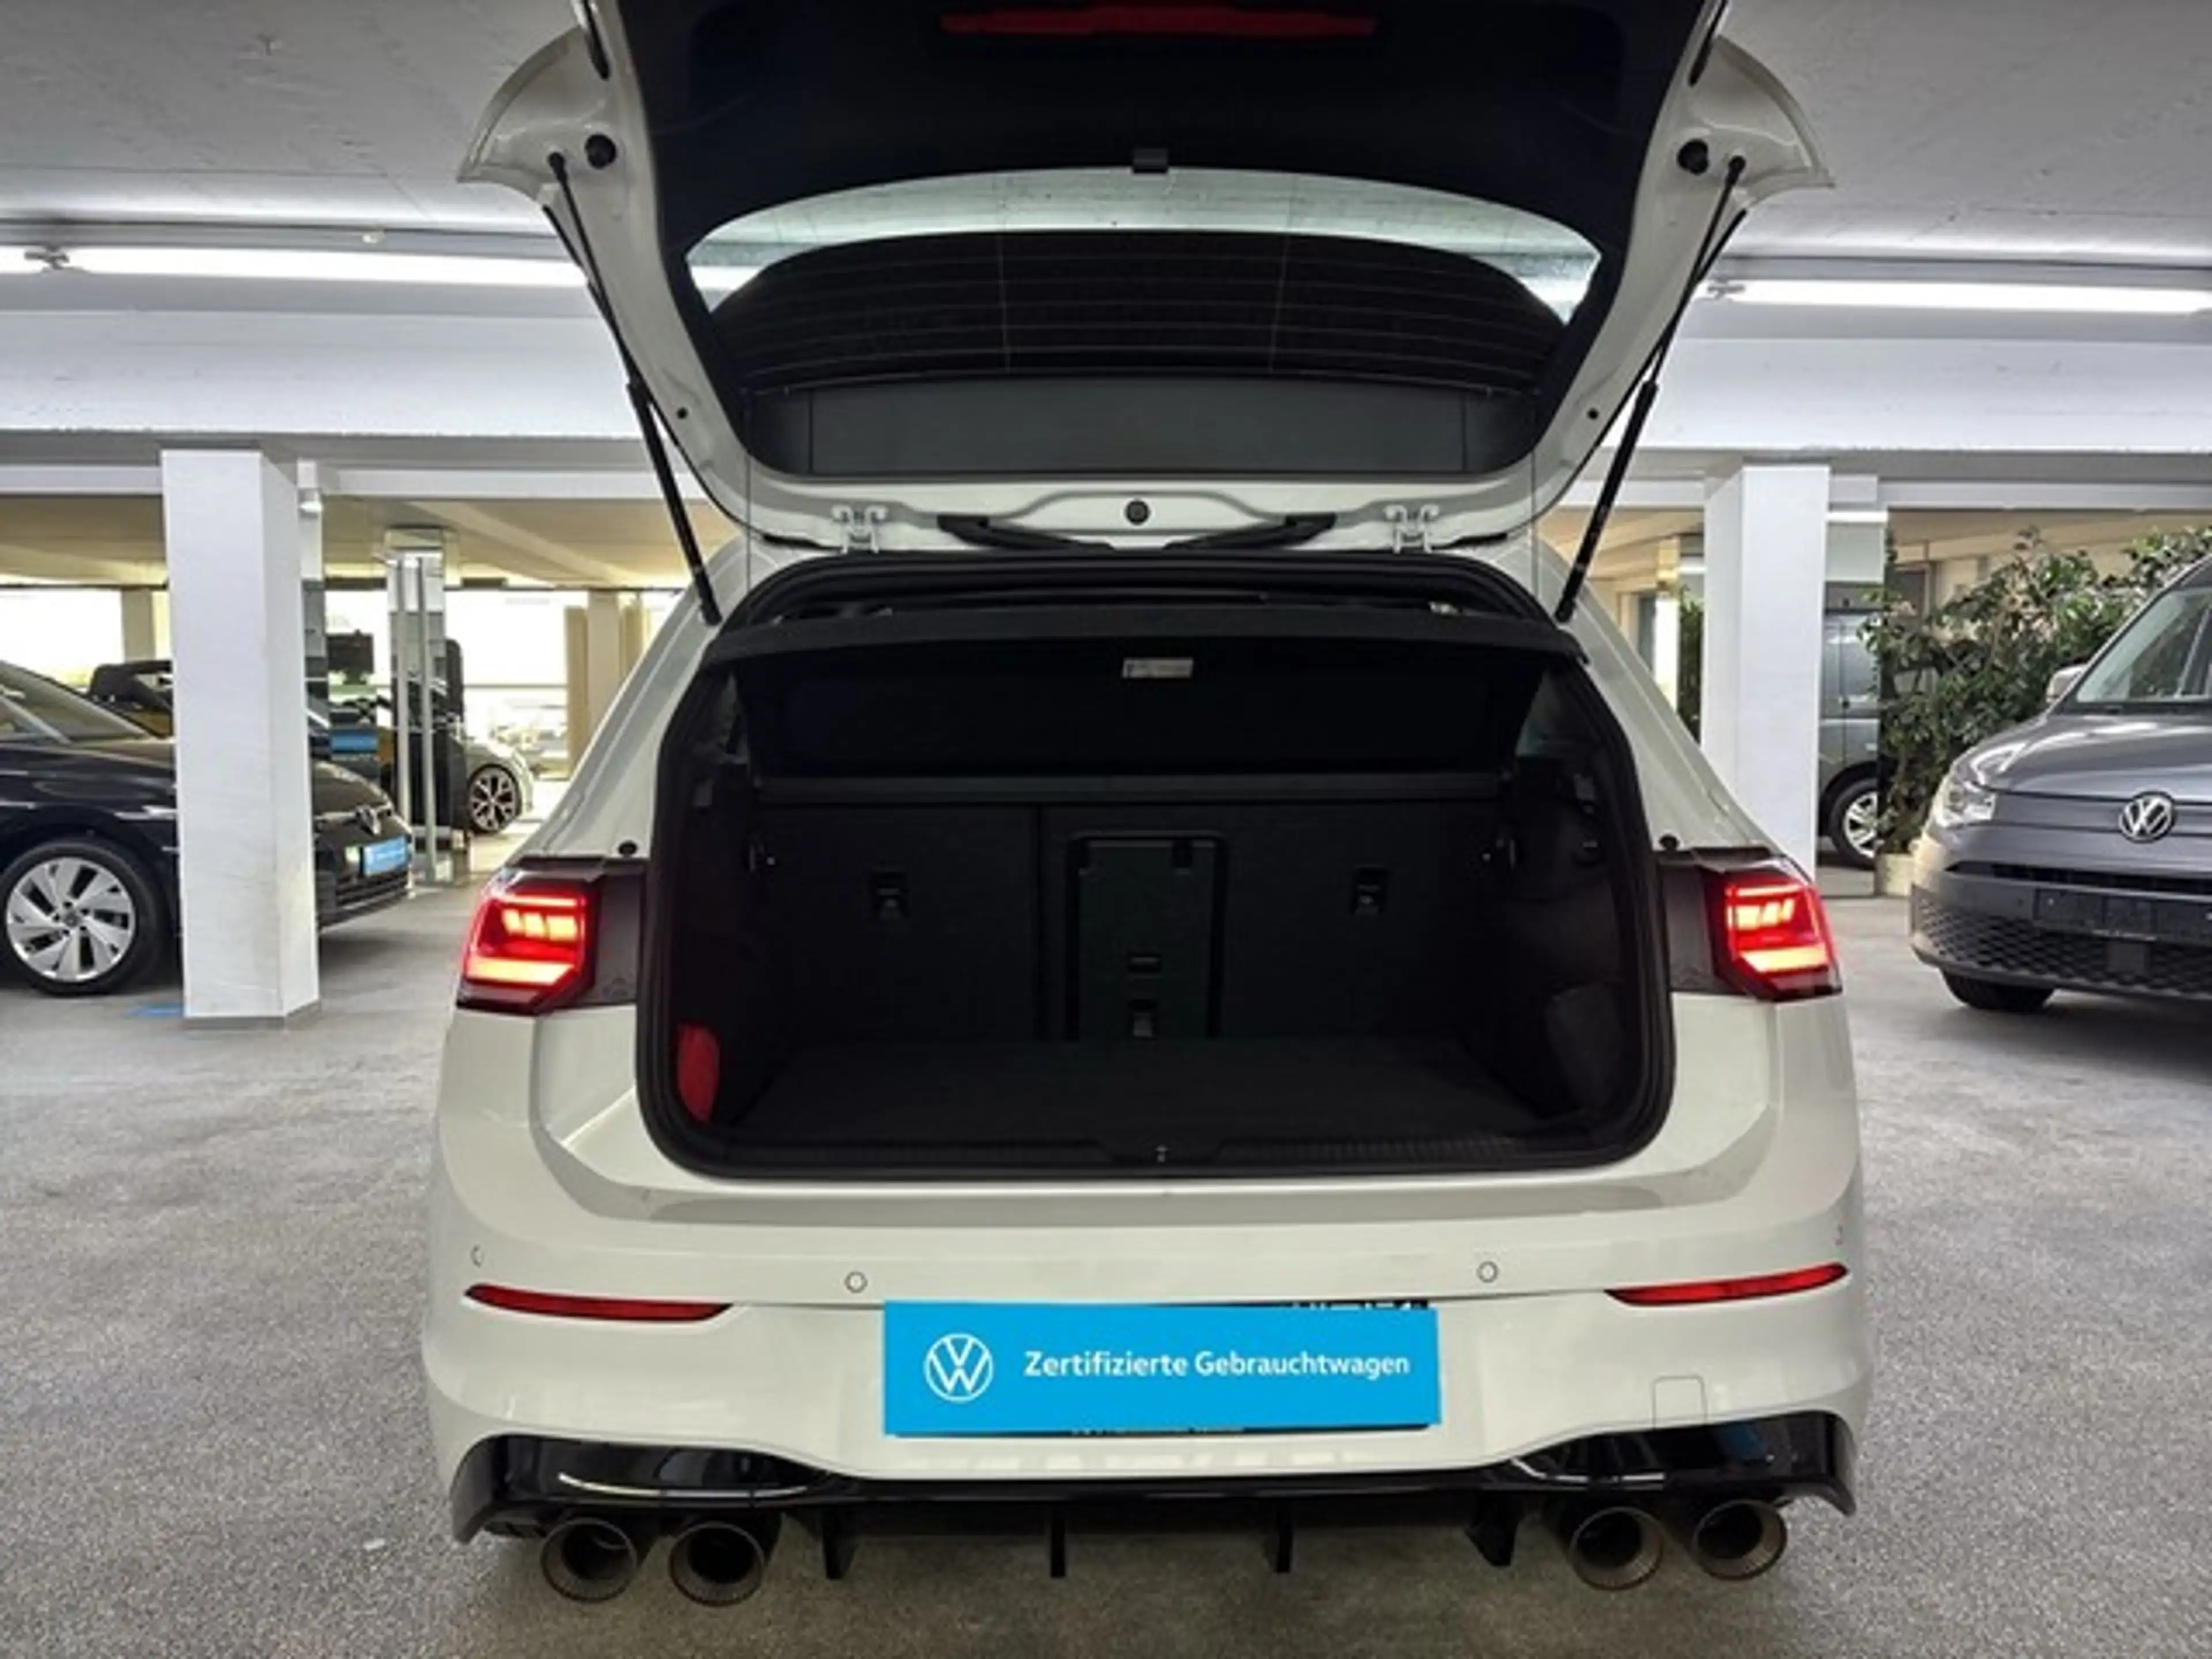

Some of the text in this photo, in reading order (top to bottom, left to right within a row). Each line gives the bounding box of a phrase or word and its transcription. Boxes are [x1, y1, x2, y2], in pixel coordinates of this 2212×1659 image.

[923, 1334, 994, 1403] VW
[1024, 1350, 1410, 1380] Zertifizierte Gebrauchtwagen
